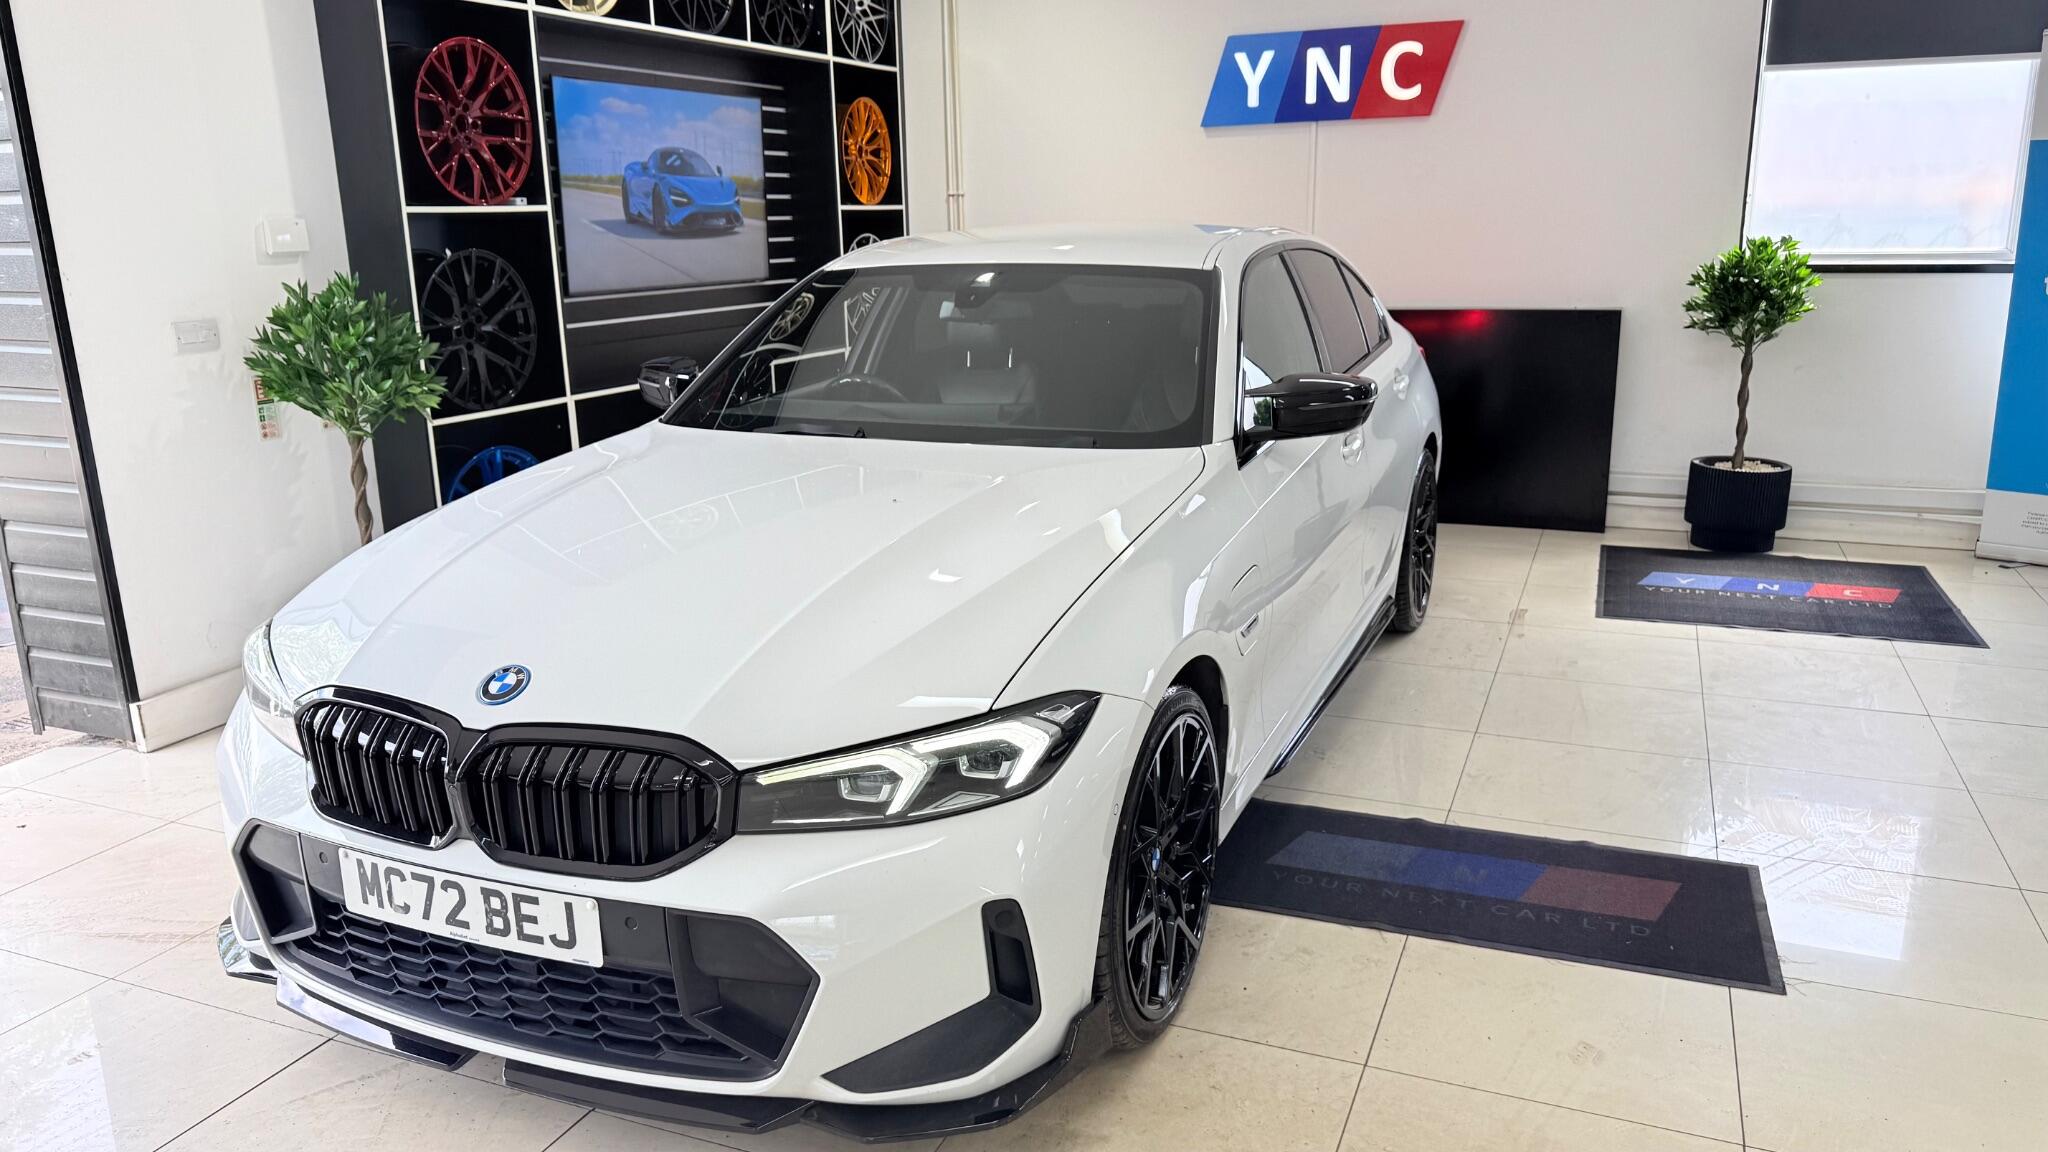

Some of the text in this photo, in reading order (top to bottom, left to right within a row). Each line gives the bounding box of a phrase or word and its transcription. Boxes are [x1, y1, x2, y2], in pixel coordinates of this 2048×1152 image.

[1234, 40, 1424, 108] YNC
[1644, 586, 1893, 609] YOUR NEXT CAR LTD
[355, 858, 577, 950] MC72 BEJ
[1272, 870, 1650, 936] YOUR NEXT CAR LTD
